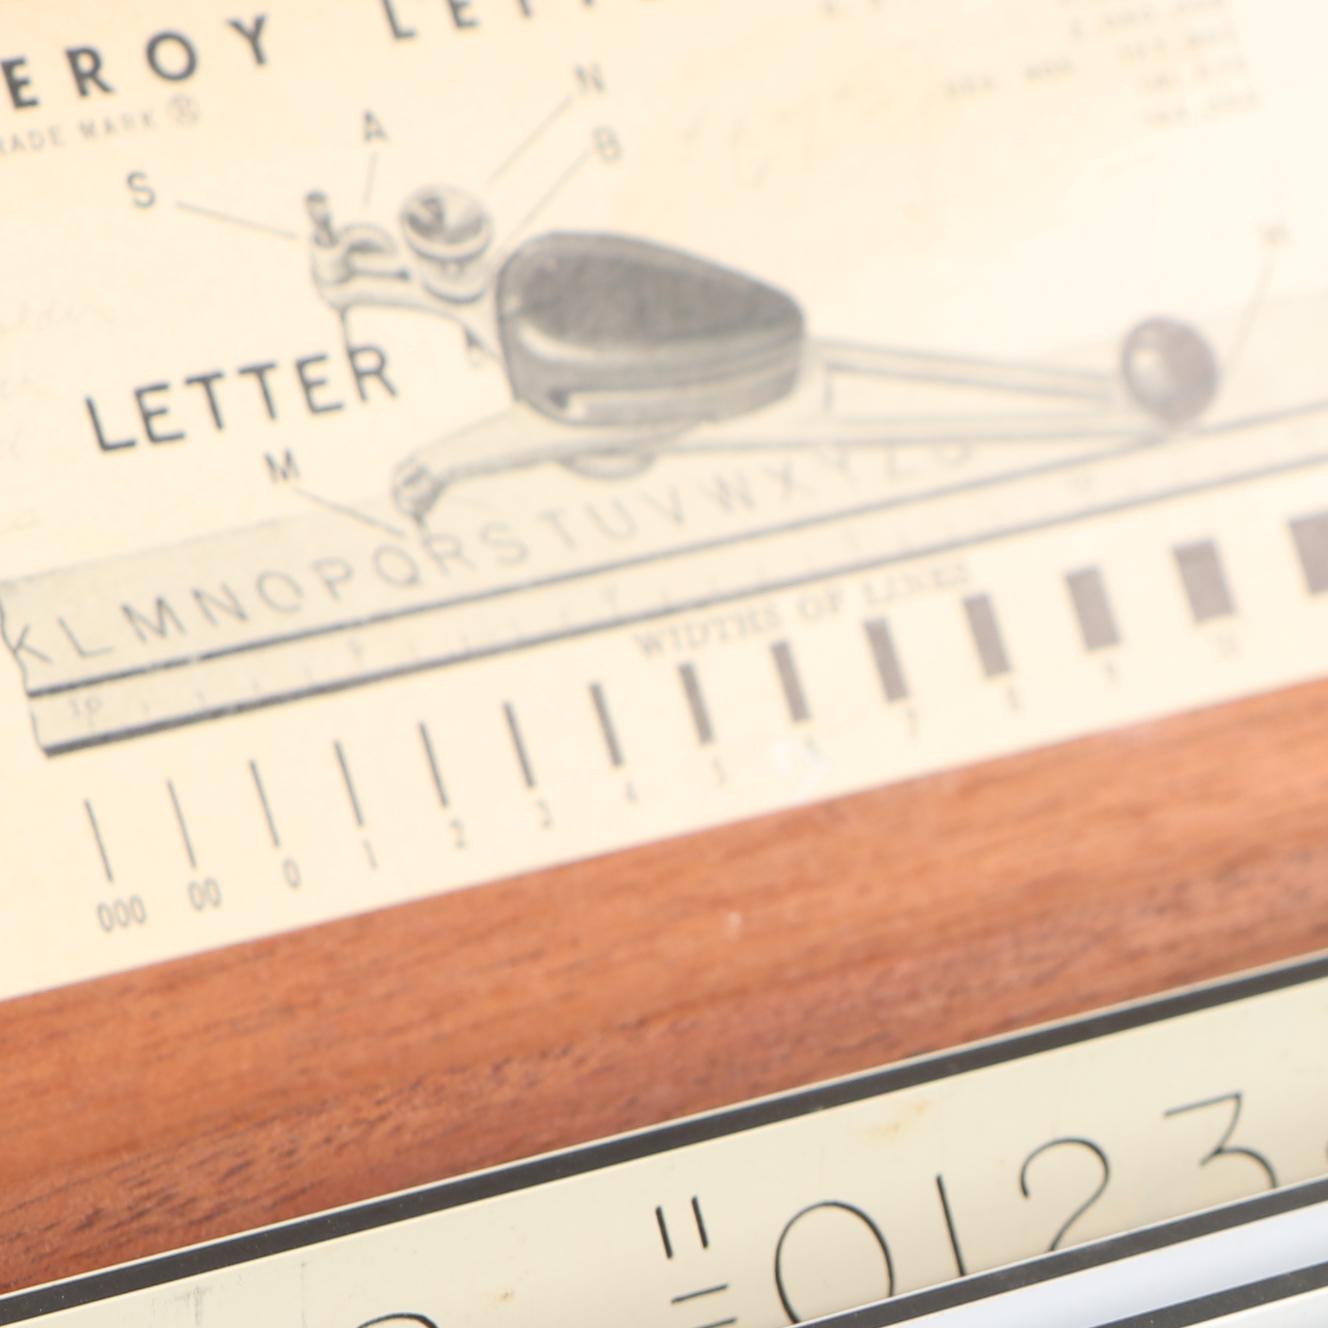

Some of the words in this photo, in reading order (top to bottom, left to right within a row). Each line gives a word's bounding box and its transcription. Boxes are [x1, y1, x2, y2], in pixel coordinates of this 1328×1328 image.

[0, 124, 65, 155] ADE
[362, 109, 389, 143] A
[126, 170, 157, 209] S
[85, 343, 398, 454] LETTER
[265, 449, 301, 485] M
[97, 894, 147, 933] 000
[188, 876, 223, 911] 00
